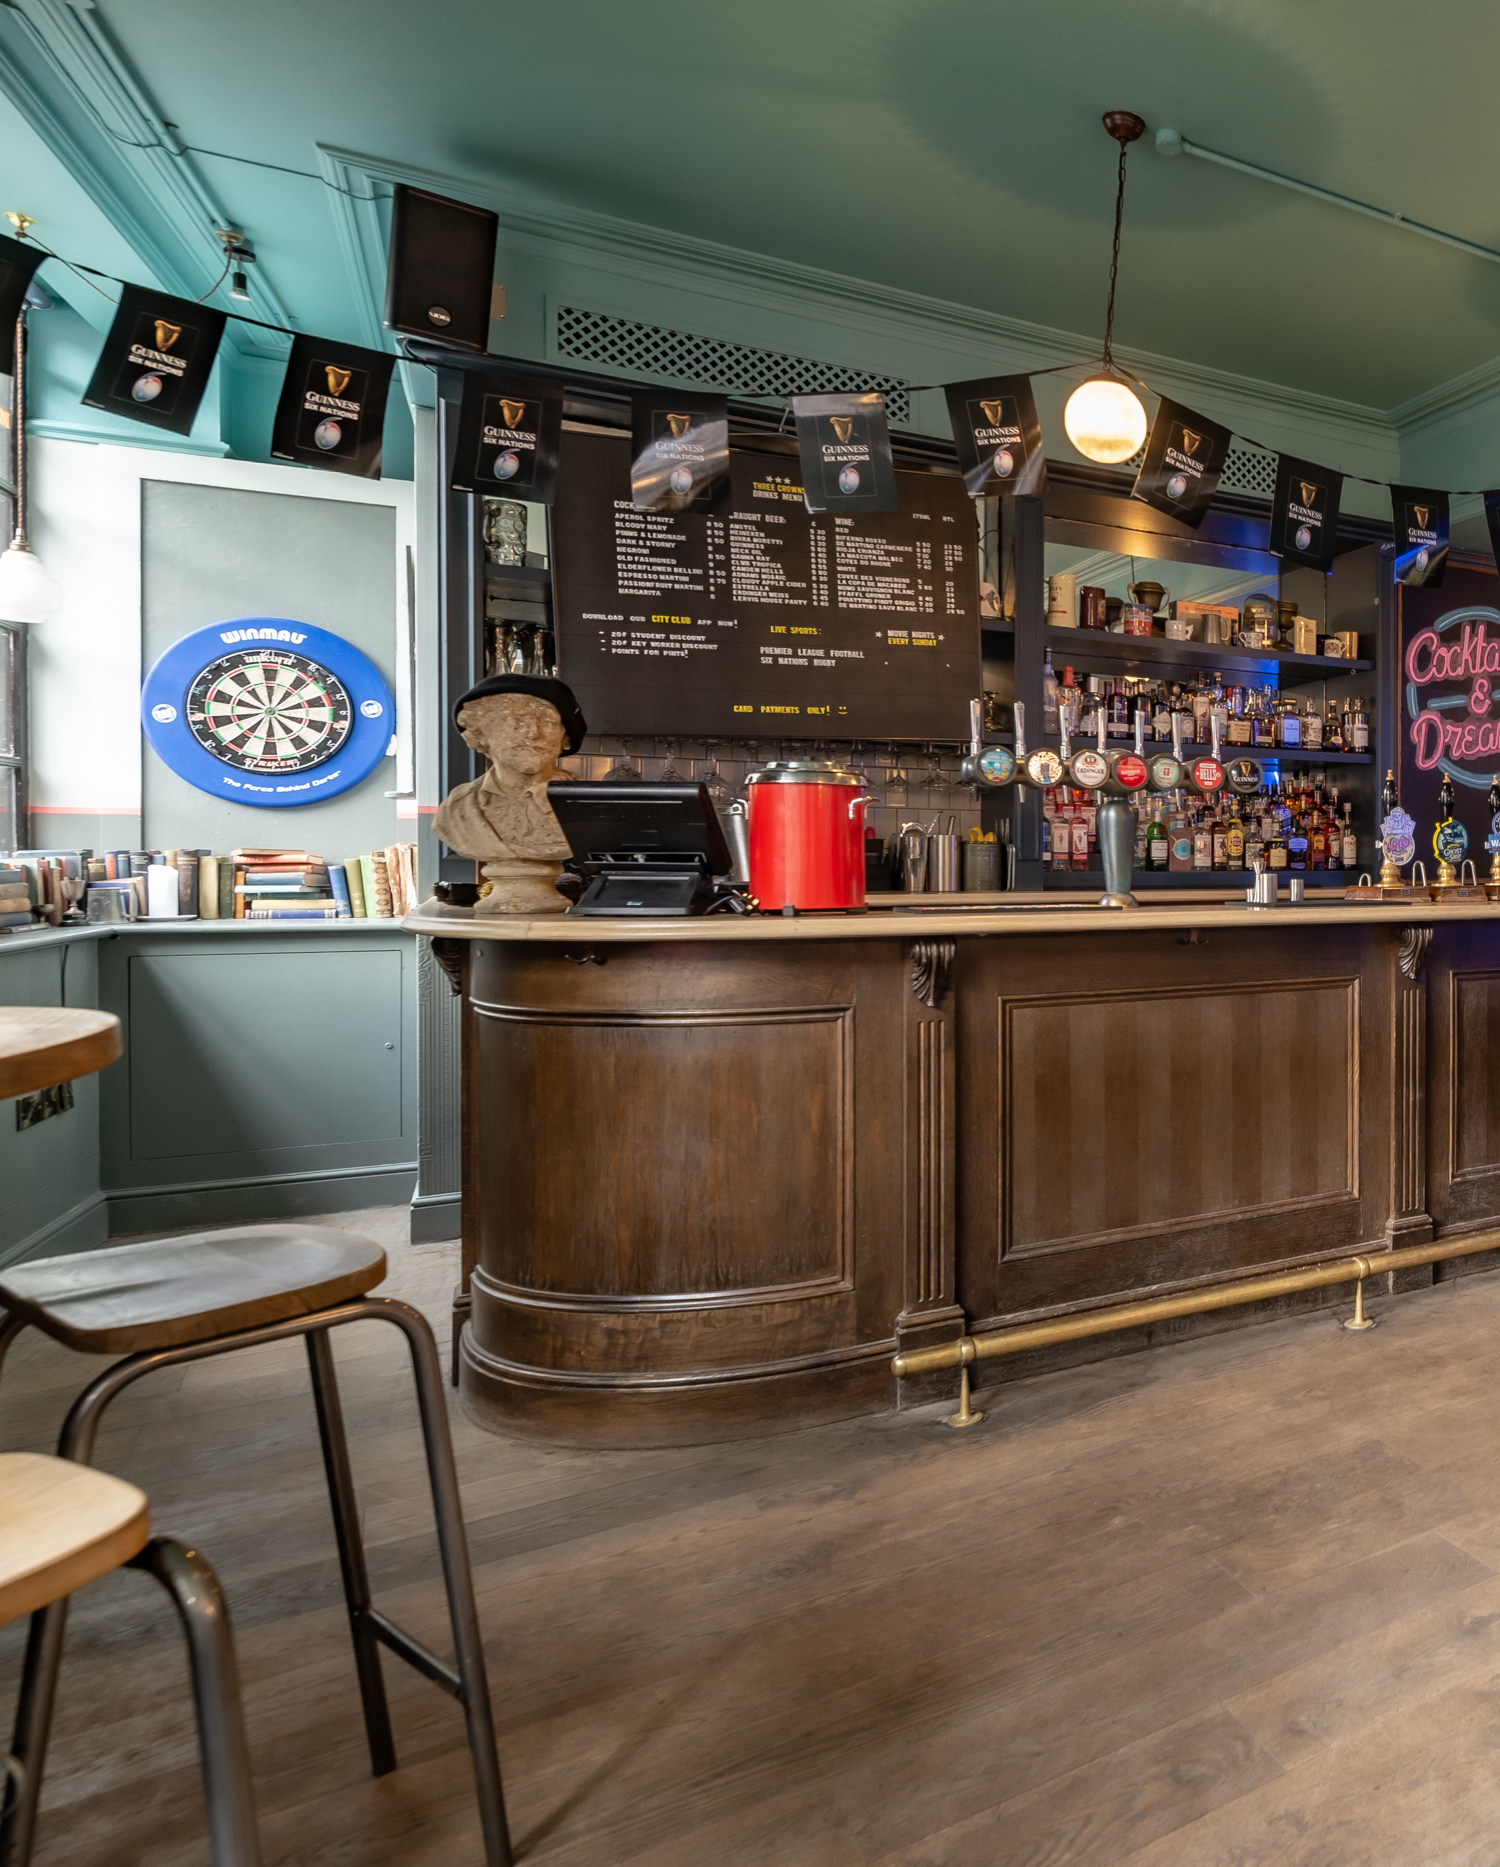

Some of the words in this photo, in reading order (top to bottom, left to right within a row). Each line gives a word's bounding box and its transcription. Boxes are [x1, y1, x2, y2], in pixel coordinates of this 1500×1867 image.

[131, 344, 187, 368] GUINNESS
[128, 355, 143, 364] SIX
[144, 360, 183, 377] NATIONS
[306, 391, 360, 411] GUINNESS
[304, 402, 318, 411] SIX
[320, 406, 358, 420] NATIONS
[484, 426, 536, 441] GUINNESS
[975, 426, 1019, 437] GUINNESS
[483, 437, 497, 445] SIX
[498, 439, 535, 450] NATIONS
[990, 436, 1021, 444] NATIONS
[655, 441, 704, 453] GUINNESS
[822, 445, 869, 453] GUINNESS
[670, 453, 704, 461] NATIONS
[1167, 447, 1203, 471] GUINNESS
[1165, 456, 1175, 465] SIX
[1176, 461, 1201, 478] NATIONS
[753, 482, 775, 491] THREE
[777, 485, 805, 494] CROWNS
[753, 490, 778, 499] DRINKS
[782, 493, 802, 502] MENU
[615, 513, 644, 521] APEROL
[1290, 503, 1322, 520] GUINNESS
[765, 515, 786, 523] BEER:
[1298, 514, 1321, 527] NATIONS
[615, 521, 645, 529] BLOODY
[647, 533, 687, 541] LEMONADE
[1409, 528, 1437, 539] GUINNESS
[646, 540, 676, 548] STORMY
[635, 556, 677, 564] FASHIONED
[617, 563, 672, 572] ELDERFLOWER
[618, 580, 673, 589] PASSIONFRUIT
[618, 588, 661, 596] MARGARITA
[652, 615, 669, 623] CITY
[671, 616, 691, 624] CLUB
[220, 628, 308, 644] WINMAU
[771, 626, 787, 634] LIVE
[791, 627, 822, 635] SPORTS:
[888, 630, 908, 638] MOVIE
[912, 631, 934, 639] NIGHTS
[760, 647, 792, 655] PREMIER
[798, 648, 824, 657] LEAGUE
[830, 650, 865, 658] FOOTBALL
[244, 654, 292, 665] unicorn
[778, 657, 808, 666] NATIONS
[814, 658, 836, 667] RUGBY
[1469, 677, 1492, 716] &
[734, 705, 753, 713] CARD
[761, 706, 799, 714] PAYMENTS
[807, 706, 830, 716] ONLY!
[243, 758, 298, 767] STRIKER
[1200, 769, 1216, 781] HELLS
[223, 777, 241, 789] The
[243, 784, 273, 792] Force
[276, 783, 309, 792] Behind
[312, 770, 341, 786] Darts
